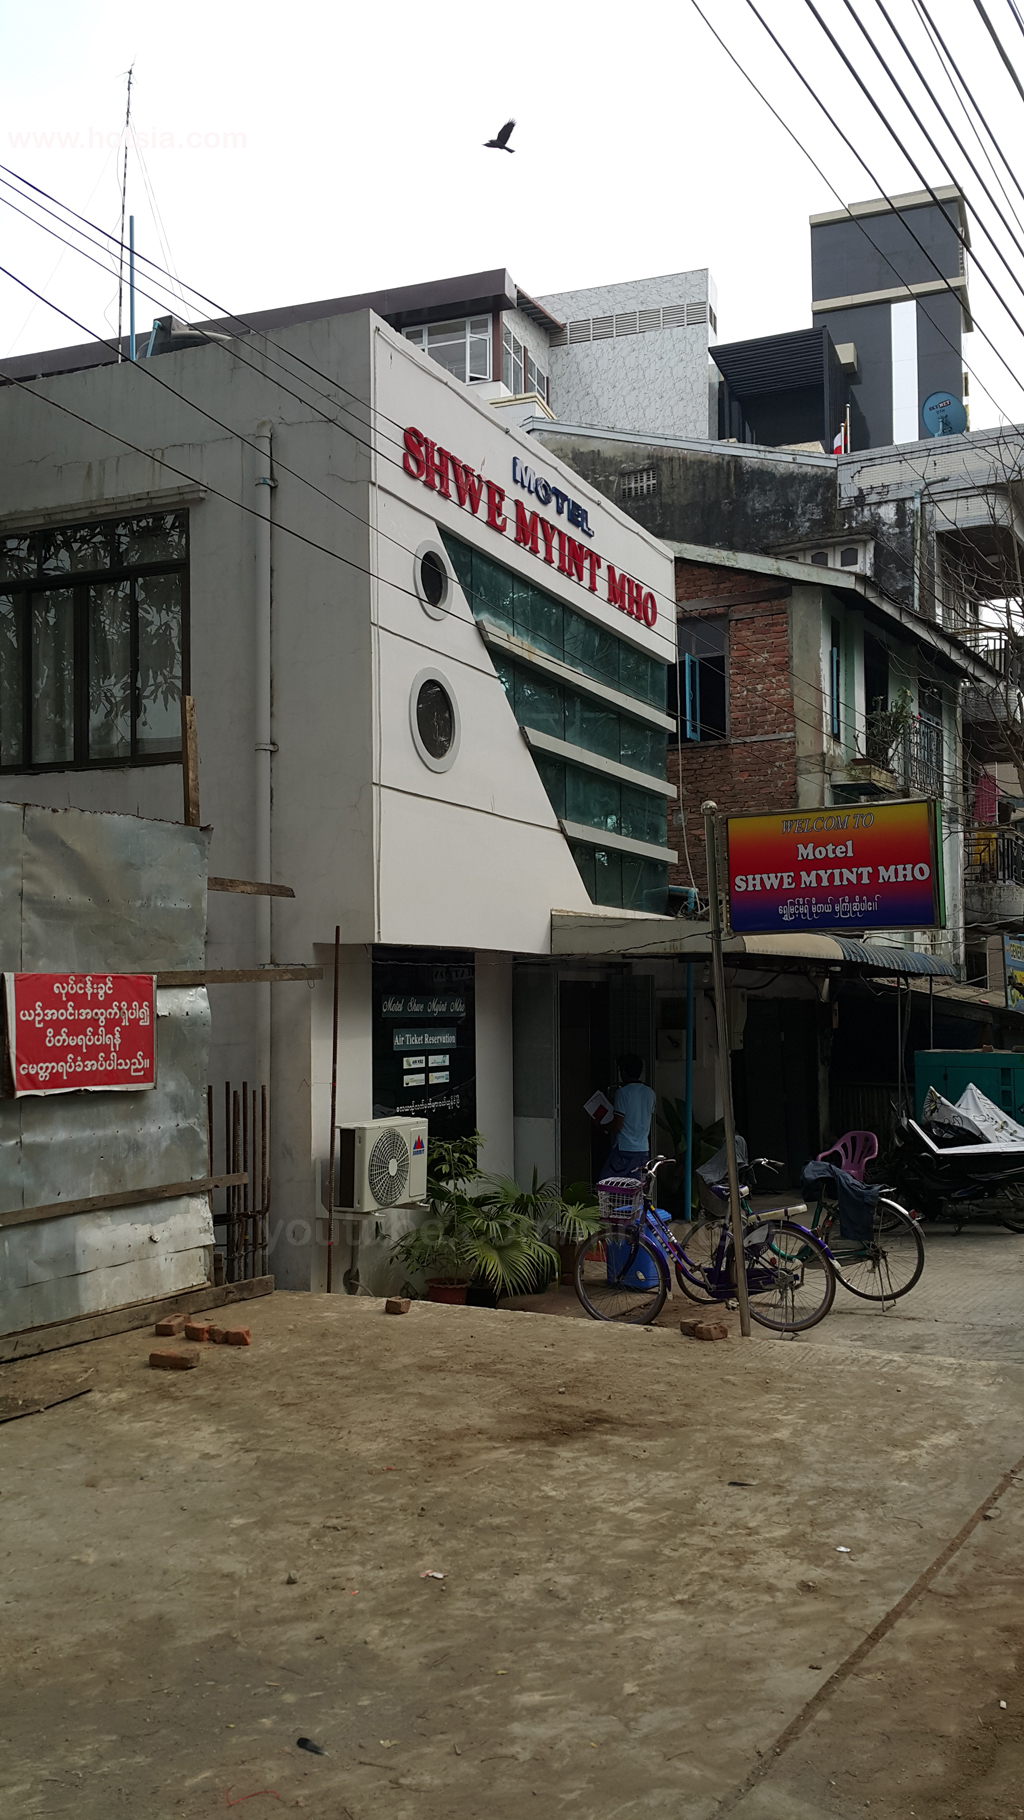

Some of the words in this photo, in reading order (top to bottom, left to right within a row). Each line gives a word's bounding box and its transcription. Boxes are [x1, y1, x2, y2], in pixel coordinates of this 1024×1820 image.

[512, 456, 595, 537] MOTEL
[402, 426, 507, 533] SHWE
[514, 499, 601, 592] MYINT
[607, 564, 658, 627] MHO
[782, 814, 850, 834] WELCOM
[853, 812, 874, 829] TO
[797, 840, 854, 860] Motel
[734, 872, 796, 892] SHWE
[800, 866, 873, 888] MYINT
[877, 862, 930, 883] MHO
[382, 996, 405, 1013] Motel
[406, 997, 425, 1013] Shwe
[427, 997, 448, 1017] Myint
[449, 997, 466, 1013] Mho
[394, 1034, 404, 1046] Air
[405, 1033, 424, 1046] Ticket
[424, 1032, 456, 1045] Reservation
